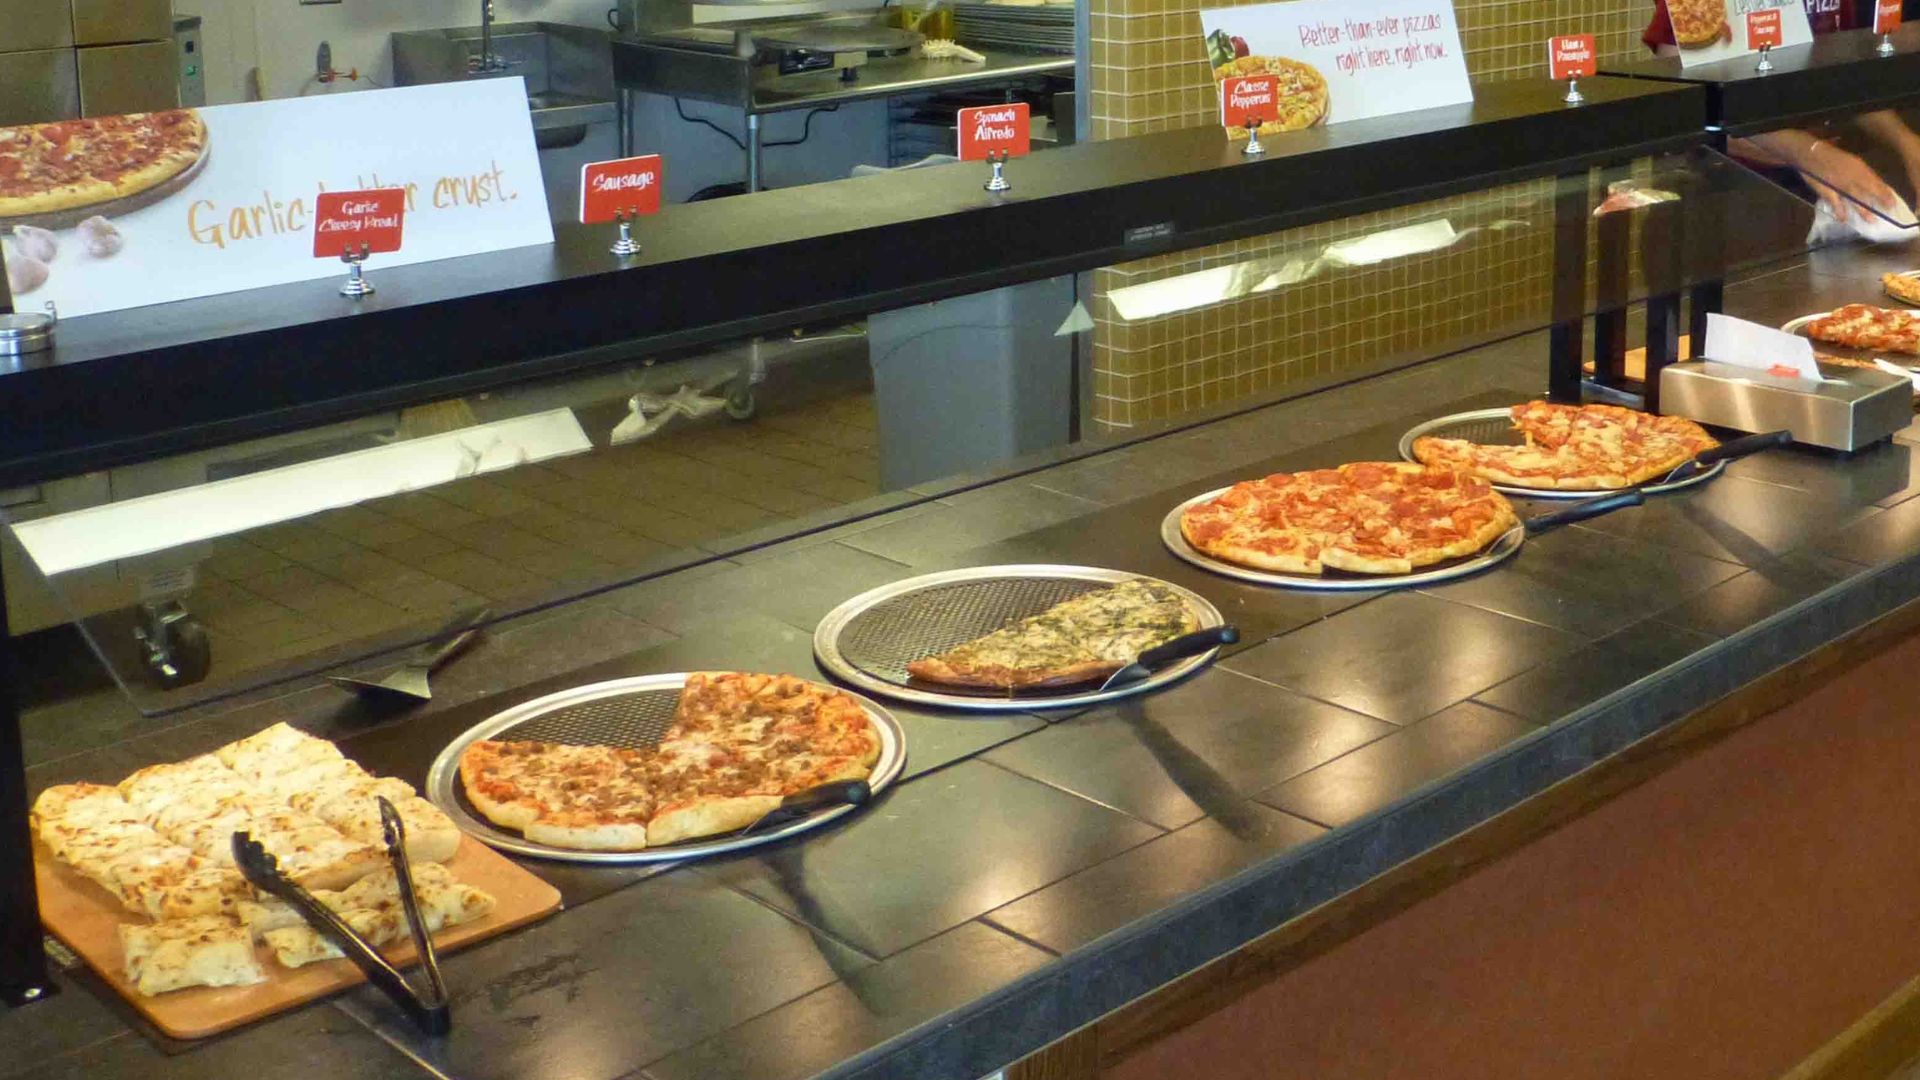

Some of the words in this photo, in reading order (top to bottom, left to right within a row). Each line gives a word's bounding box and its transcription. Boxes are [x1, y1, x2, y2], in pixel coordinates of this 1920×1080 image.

[1298, 16, 1399, 48] Better-than-ever
[1403, 13, 1441, 37] pizzas
[1335, 46, 1366, 76] right
[1396, 38, 1423, 69] right
[1424, 42, 1449, 60] now.
[1230, 93, 1272, 110] Pepperoni
[974, 108, 1016, 126] Spinach
[975, 125, 1016, 141] Alfredo
[433, 160, 518, 209] crust.
[592, 171, 655, 193] Sausage
[341, 200, 379, 215] Garlic
[319, 218, 361, 232] Cheesy
